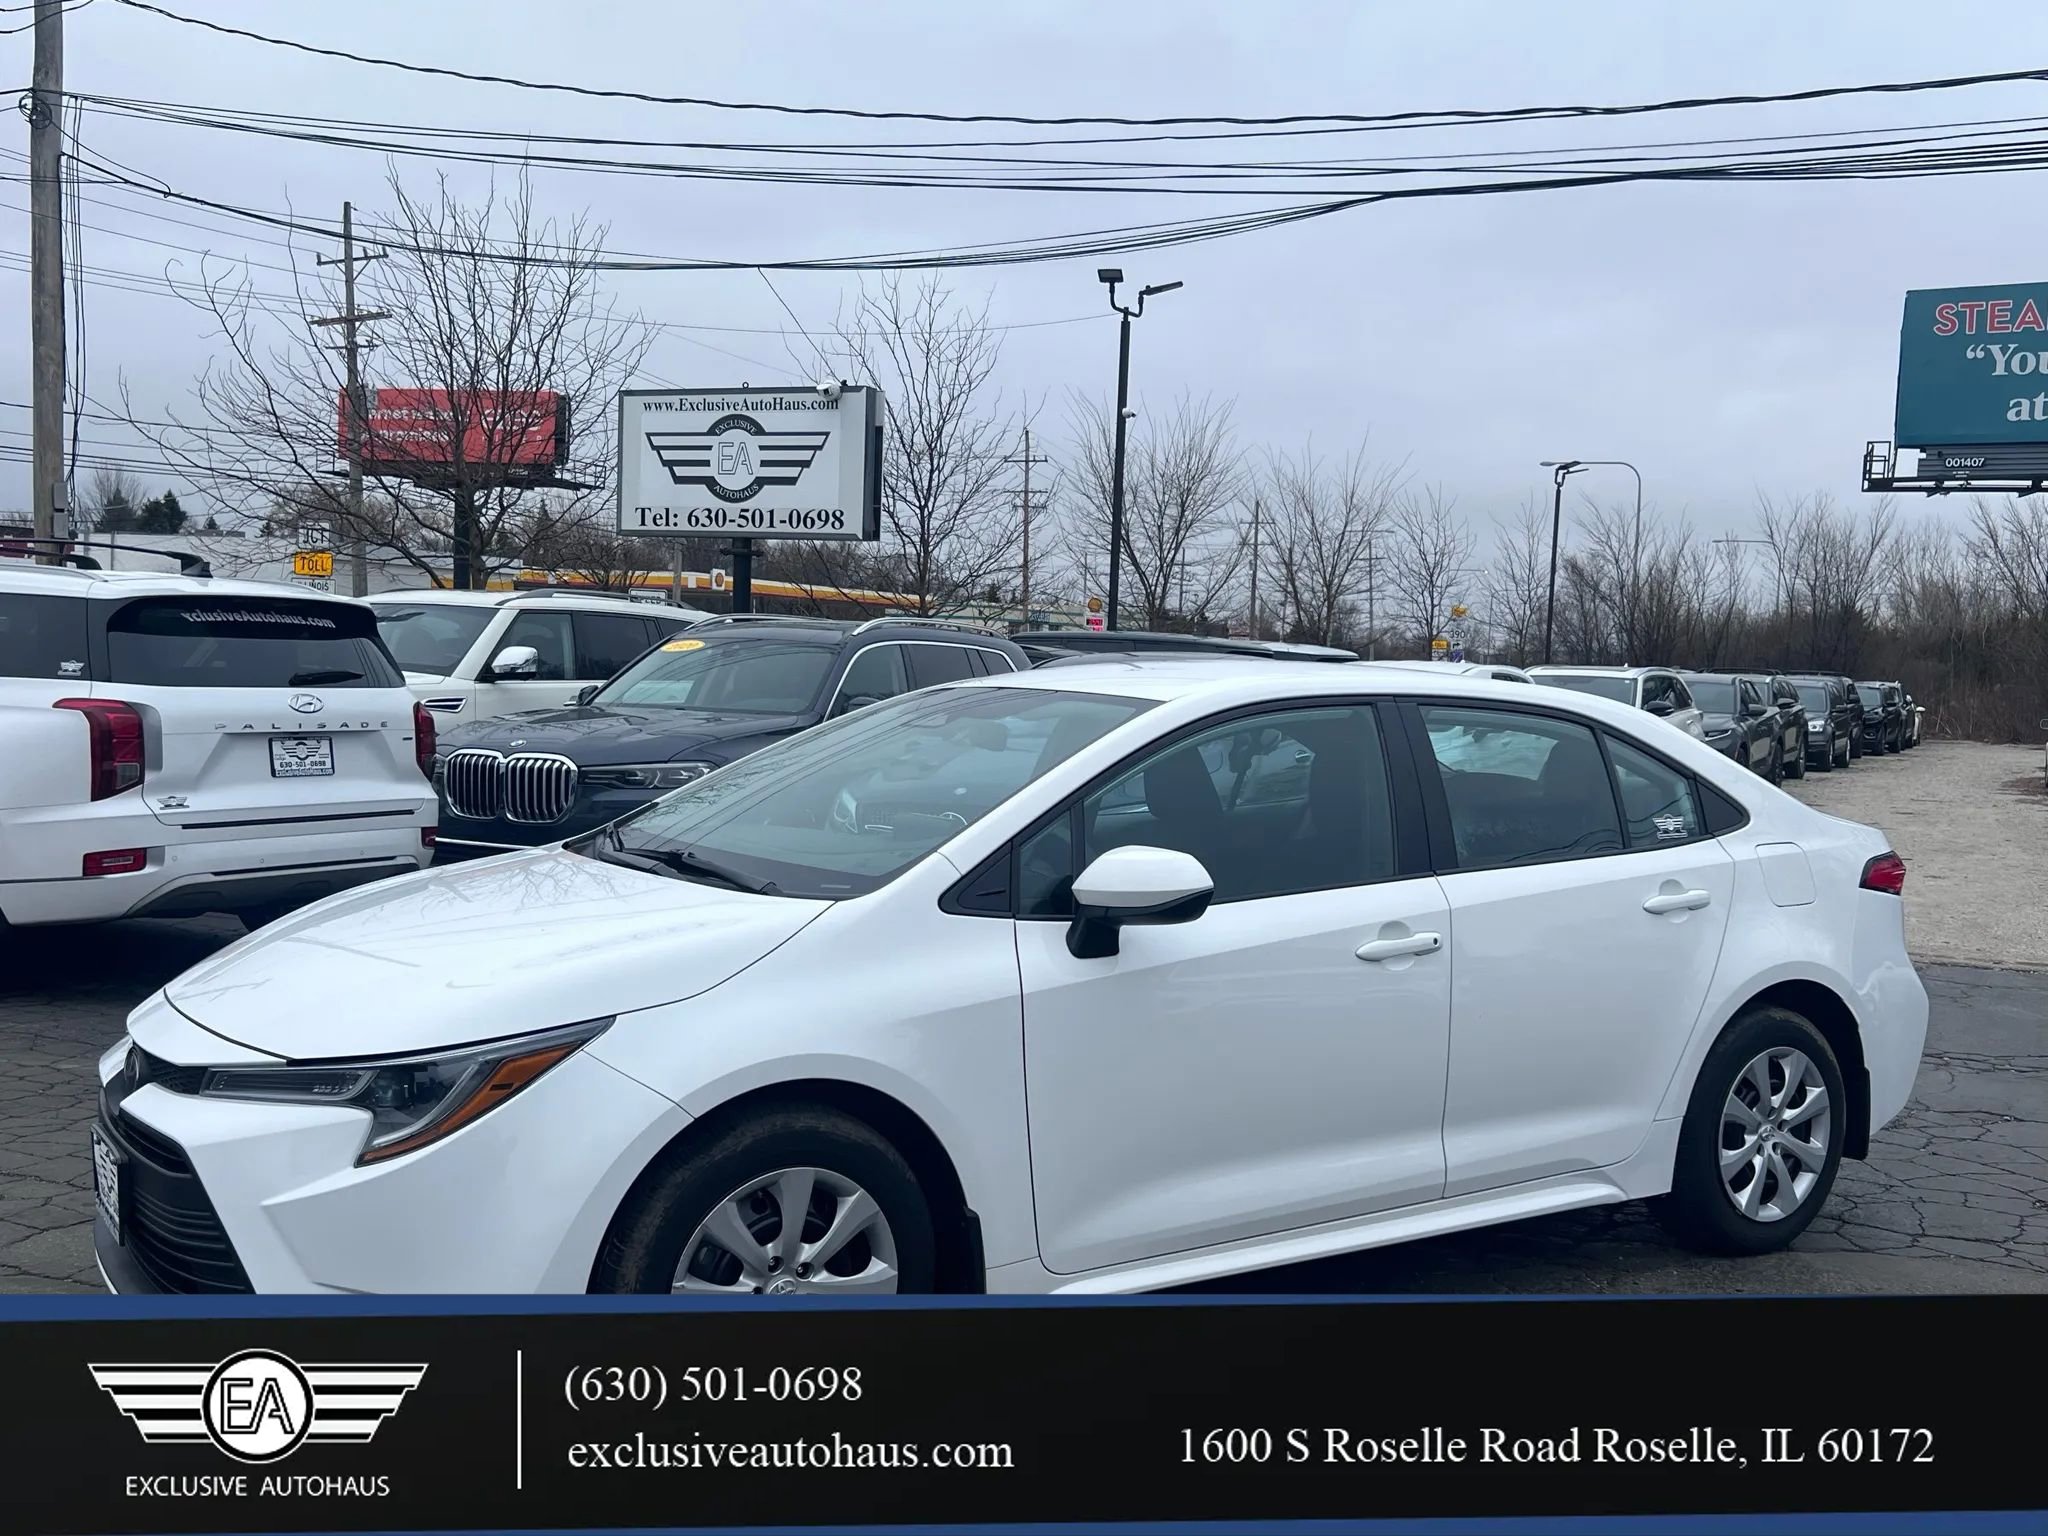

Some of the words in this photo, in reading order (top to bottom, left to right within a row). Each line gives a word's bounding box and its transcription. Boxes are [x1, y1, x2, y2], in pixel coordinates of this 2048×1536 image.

[1933, 299, 2048, 336] STEA
[643, 397, 839, 413] www.ExclusiveAutoHaus.com
[715, 418, 757, 436] EXCLUSIVE
[717, 441, 754, 475] EA
[1945, 457, 1985, 468] 001407
[713, 484, 760, 499] AUTOHAUS
[635, 507, 679, 527] Tel:
[687, 508, 845, 530] 630-501-0698
[301, 557, 327, 572] TOLL
[215, 721, 388, 730] PALISADE
[280, 760, 327, 769] 630-501-0698
